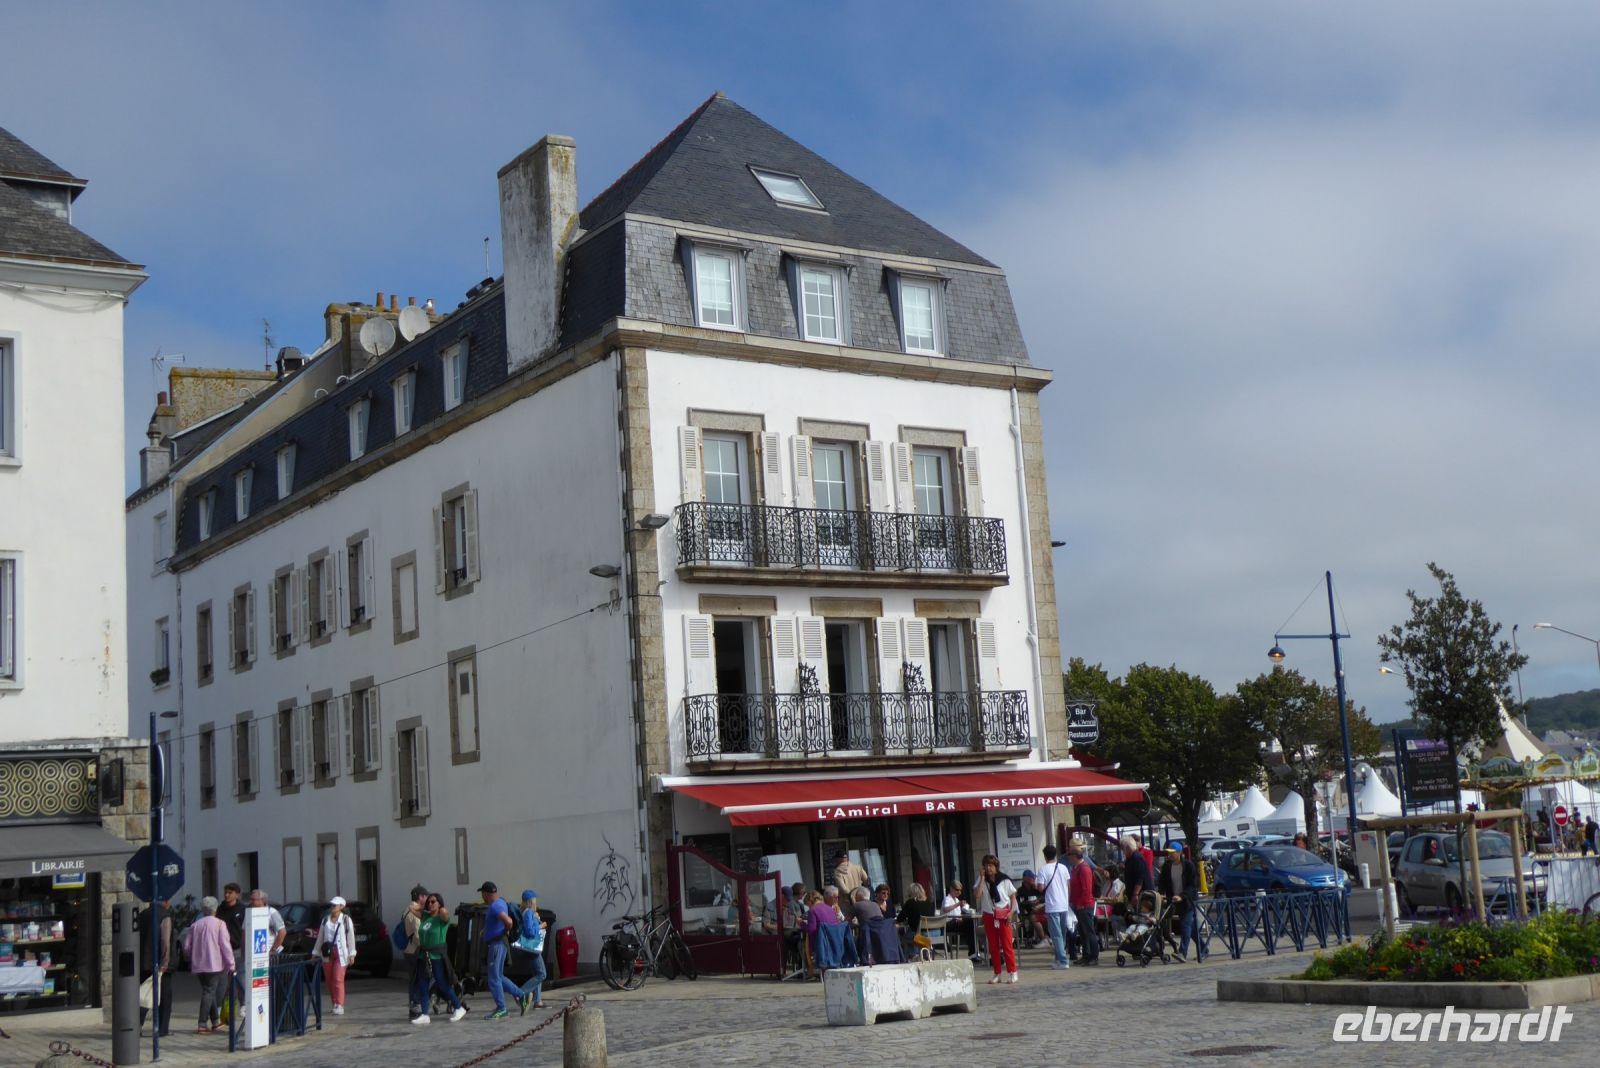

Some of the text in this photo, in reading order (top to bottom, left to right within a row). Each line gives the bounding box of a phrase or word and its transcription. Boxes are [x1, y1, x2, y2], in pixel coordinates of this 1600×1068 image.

[818, 795, 1074, 819] L'Amiral BAR RESTAURANT
[32, 860, 85, 874] LIBRAIRIE
